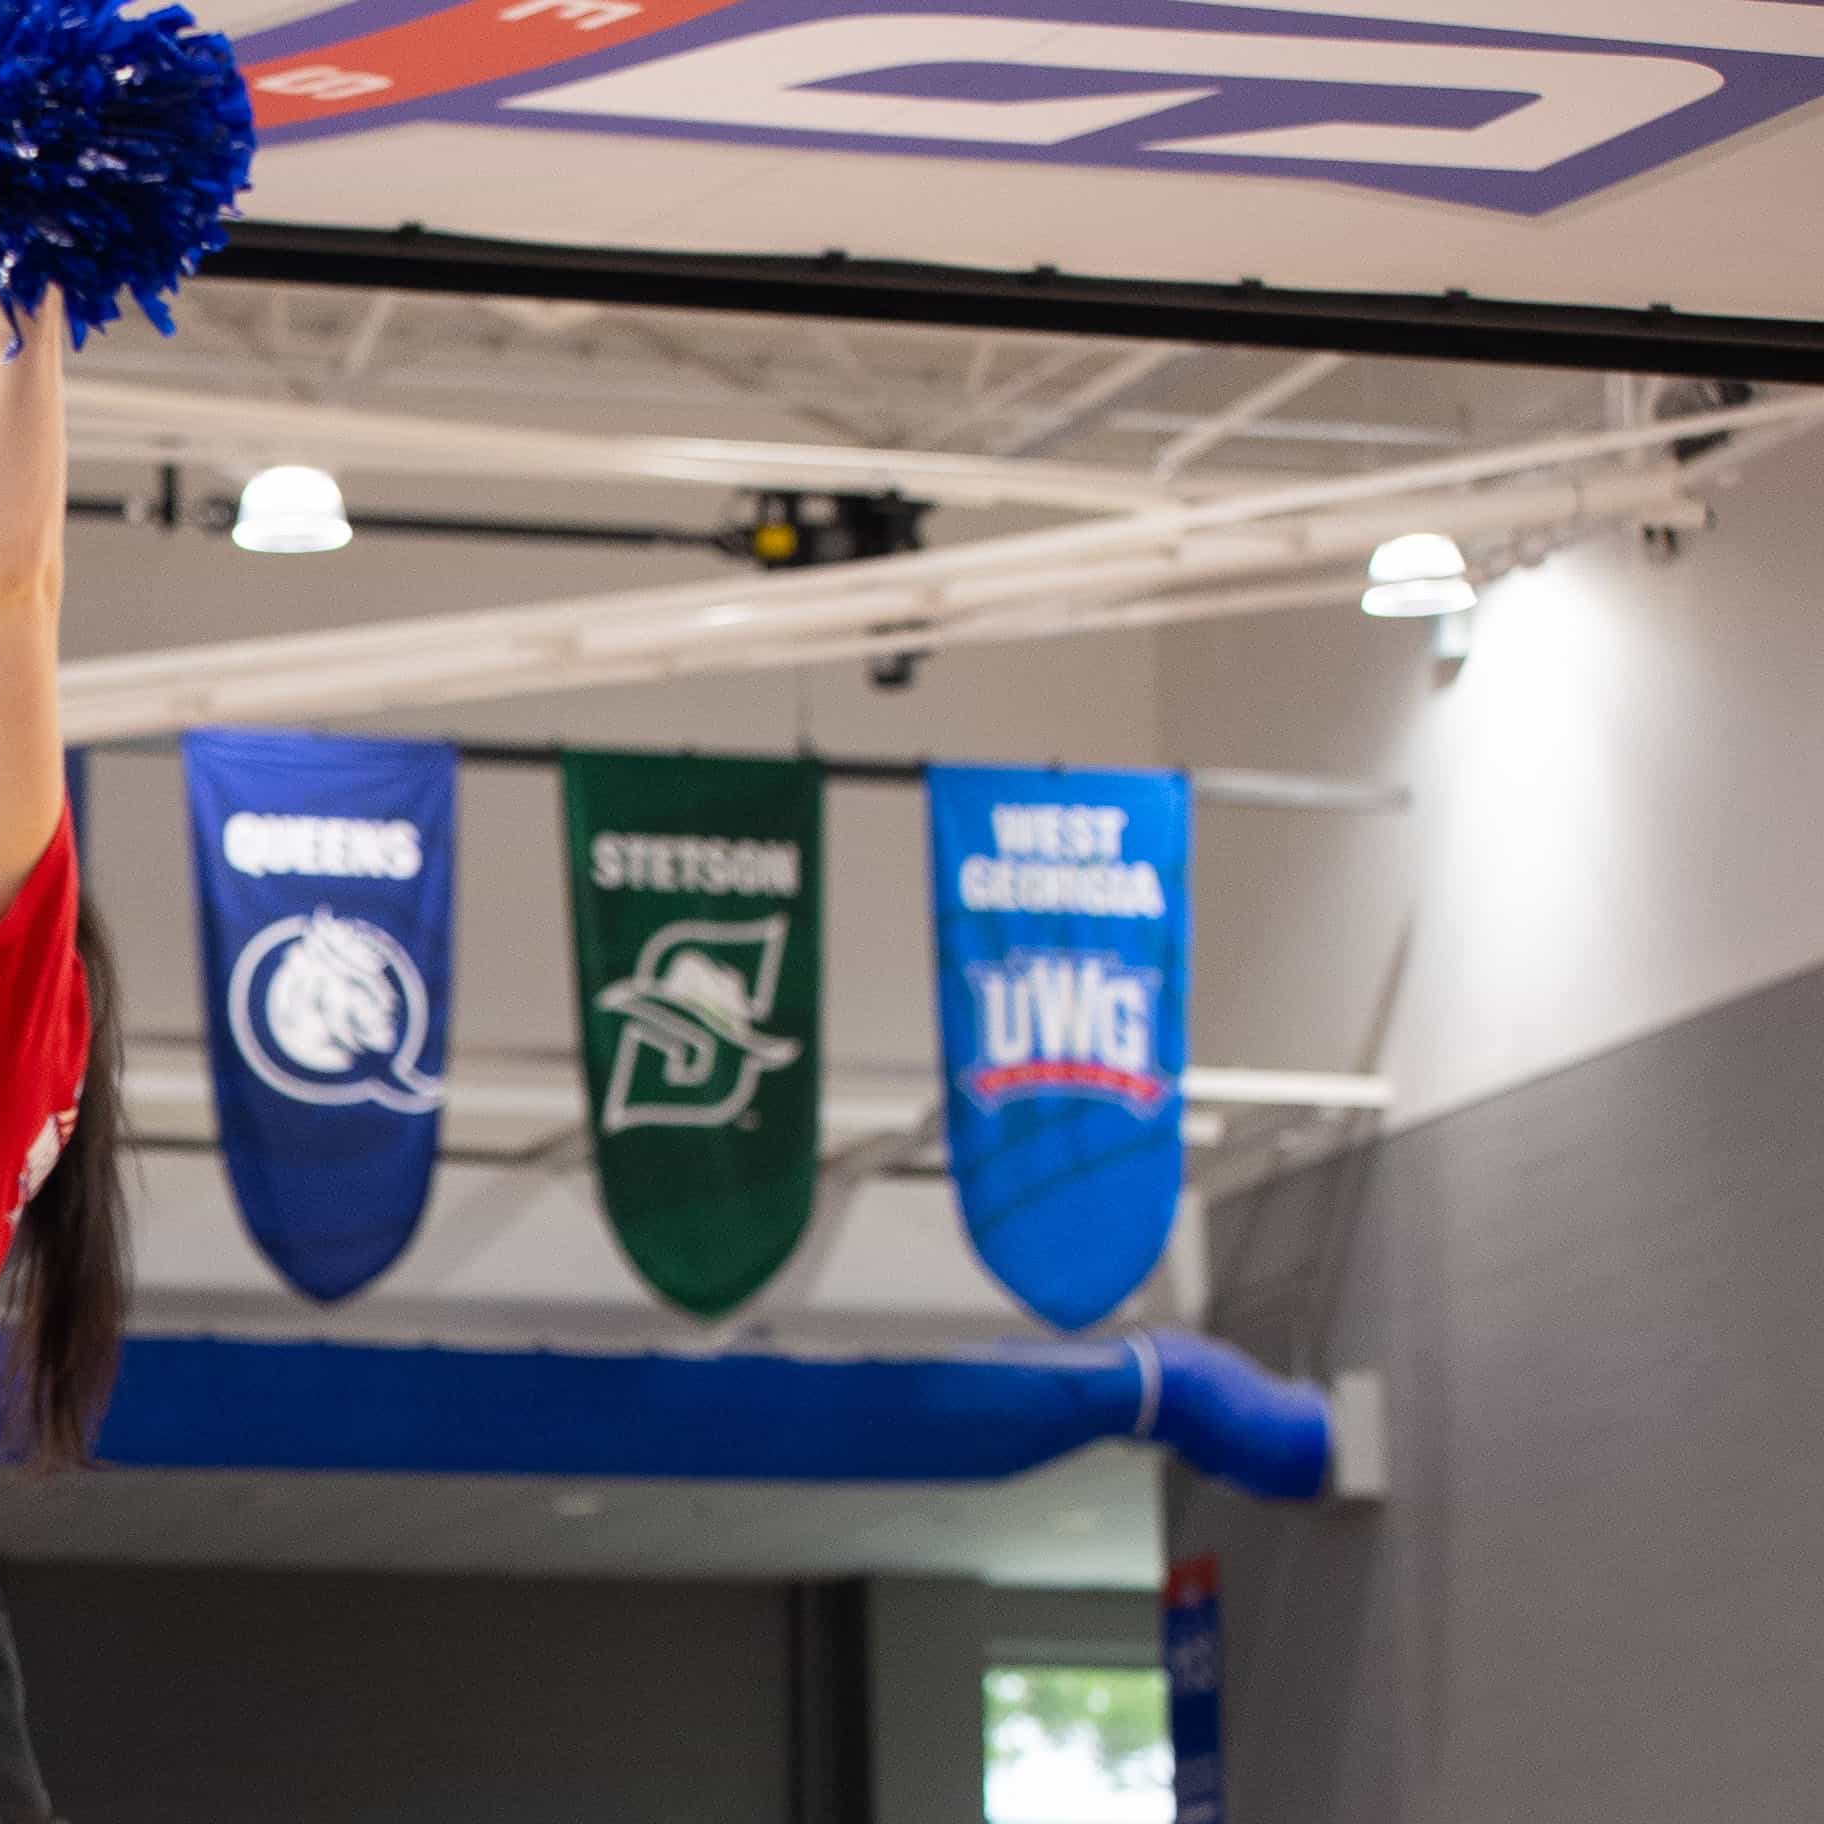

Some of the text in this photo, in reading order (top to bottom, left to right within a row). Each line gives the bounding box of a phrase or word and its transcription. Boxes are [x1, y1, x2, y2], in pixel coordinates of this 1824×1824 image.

[223, 811, 422, 880] QUEENS
[991, 803, 1128, 859] WEST
[592, 832, 798, 896] STETSON
[960, 855, 1165, 918] GEORGIA
[982, 955, 1149, 1070] UWG
